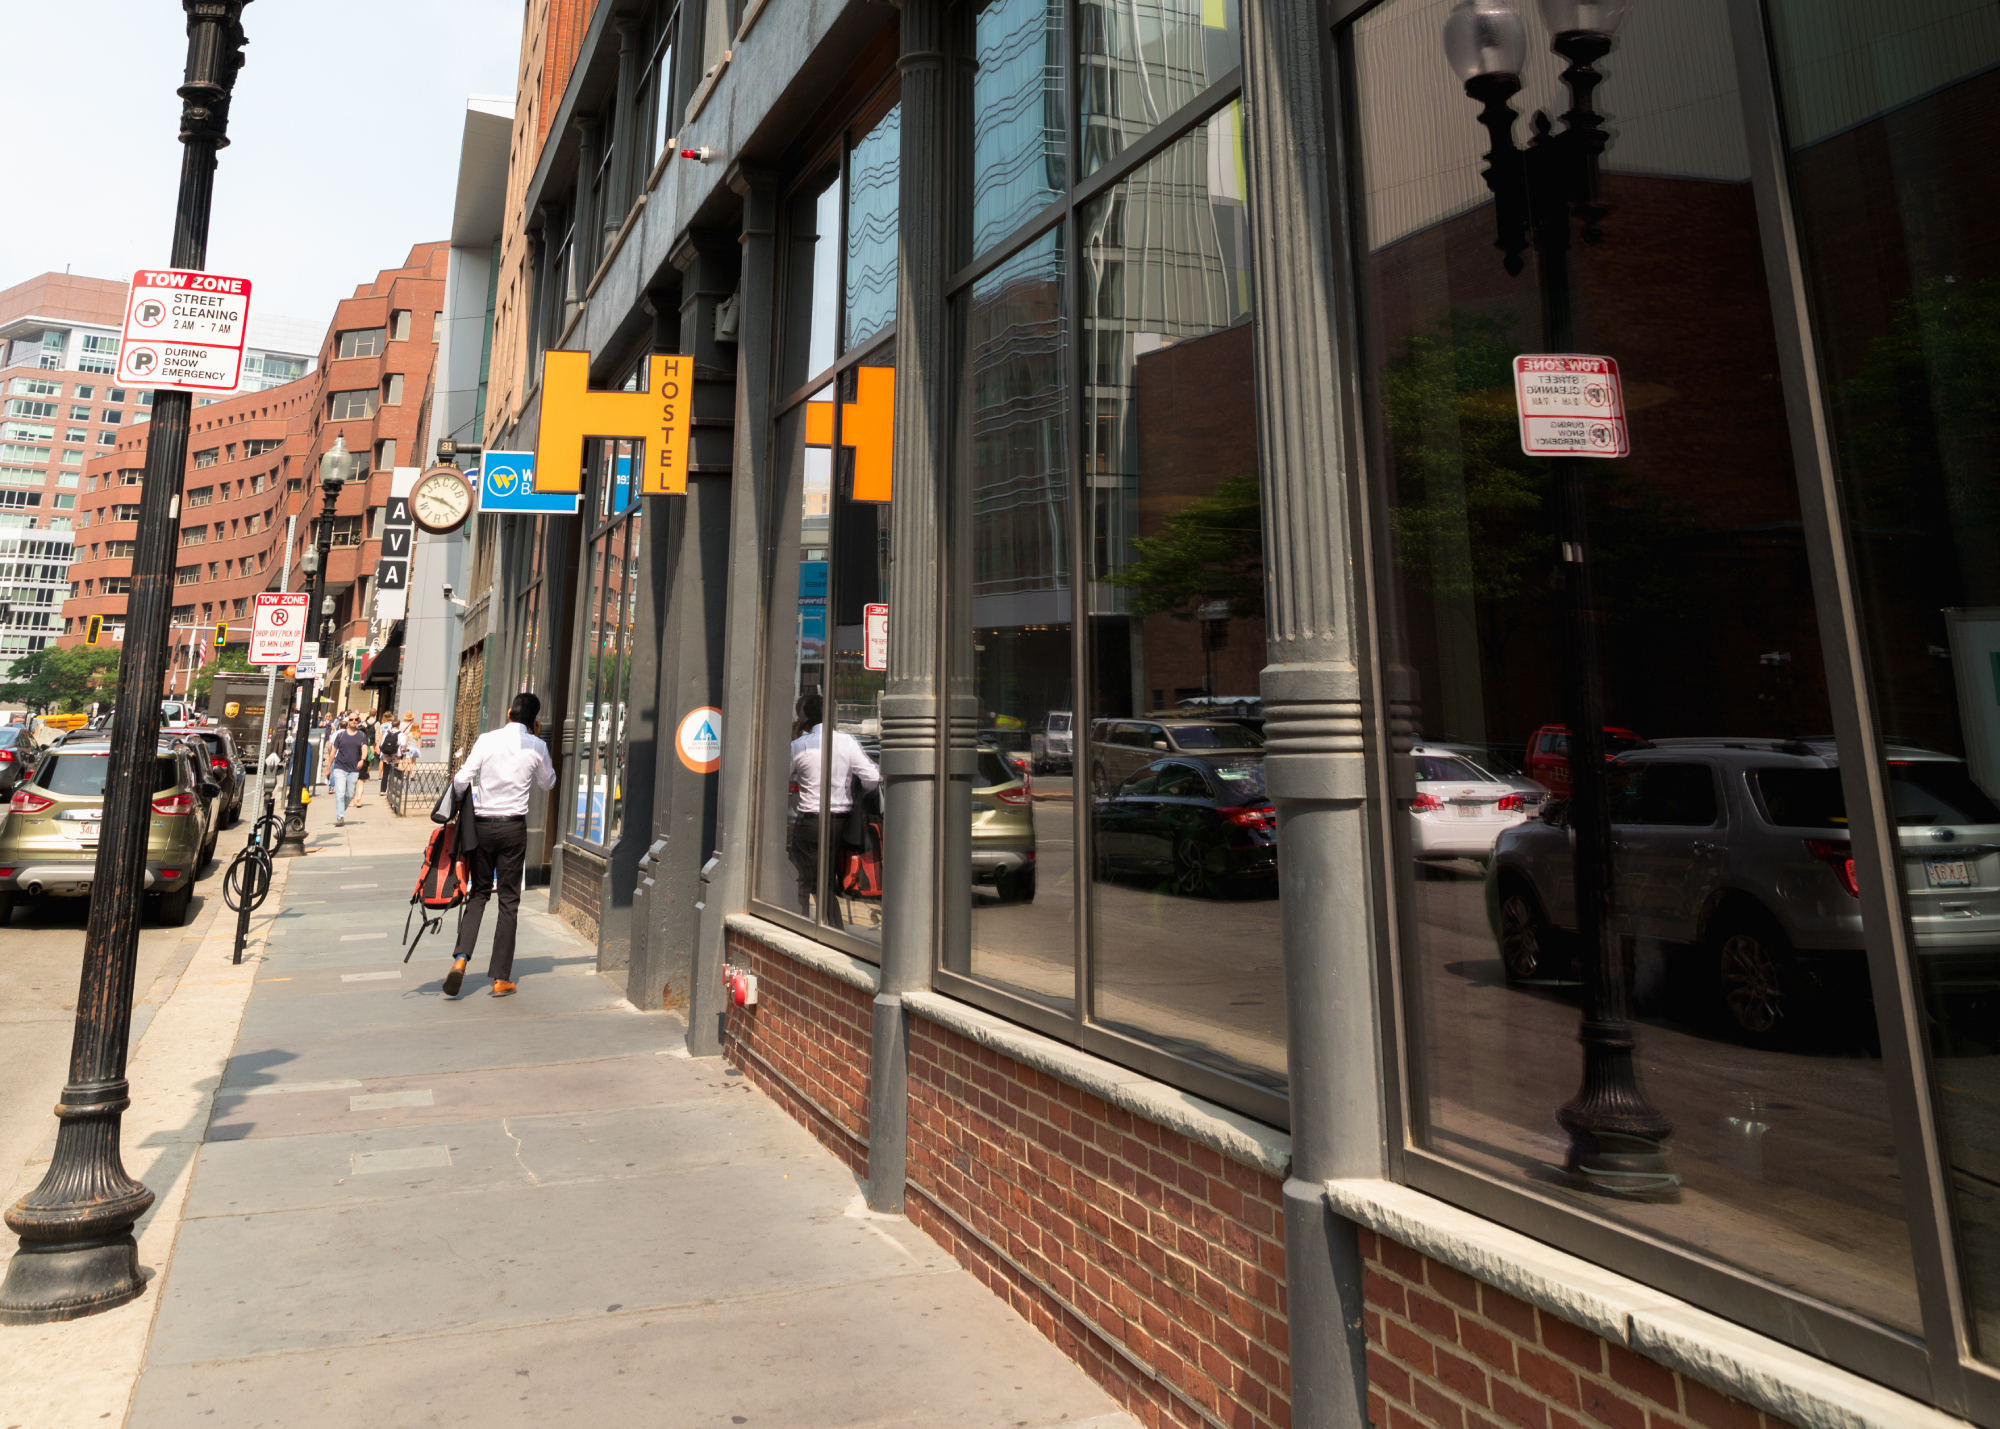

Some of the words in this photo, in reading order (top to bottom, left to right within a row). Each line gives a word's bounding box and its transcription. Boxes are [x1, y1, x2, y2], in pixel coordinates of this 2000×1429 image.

[144, 272, 187, 287] TOW
[190, 276, 242, 293] ZONE
[174, 293, 225, 307] STREET
[172, 306, 238, 321] CLEANING
[174, 320, 178, 329] 2
[181, 320, 194, 330] AM
[211, 323, 216, 332] 7
[218, 324, 231, 334] AM
[164, 348, 208, 358] DURING
[164, 358, 198, 368] SNOW
[162, 368, 226, 380] EMERGENCY
[660, 359, 679, 490] HOSTEL
[442, 442, 452, 450] 31
[426, 478, 464, 498] JACOB
[419, 502, 460, 523] WIRTH
[384, 502, 406, 584] AVA
[260, 596, 279, 604] TOW
[281, 596, 305, 604] ZONE
[80, 825, 94, 834] 34L
